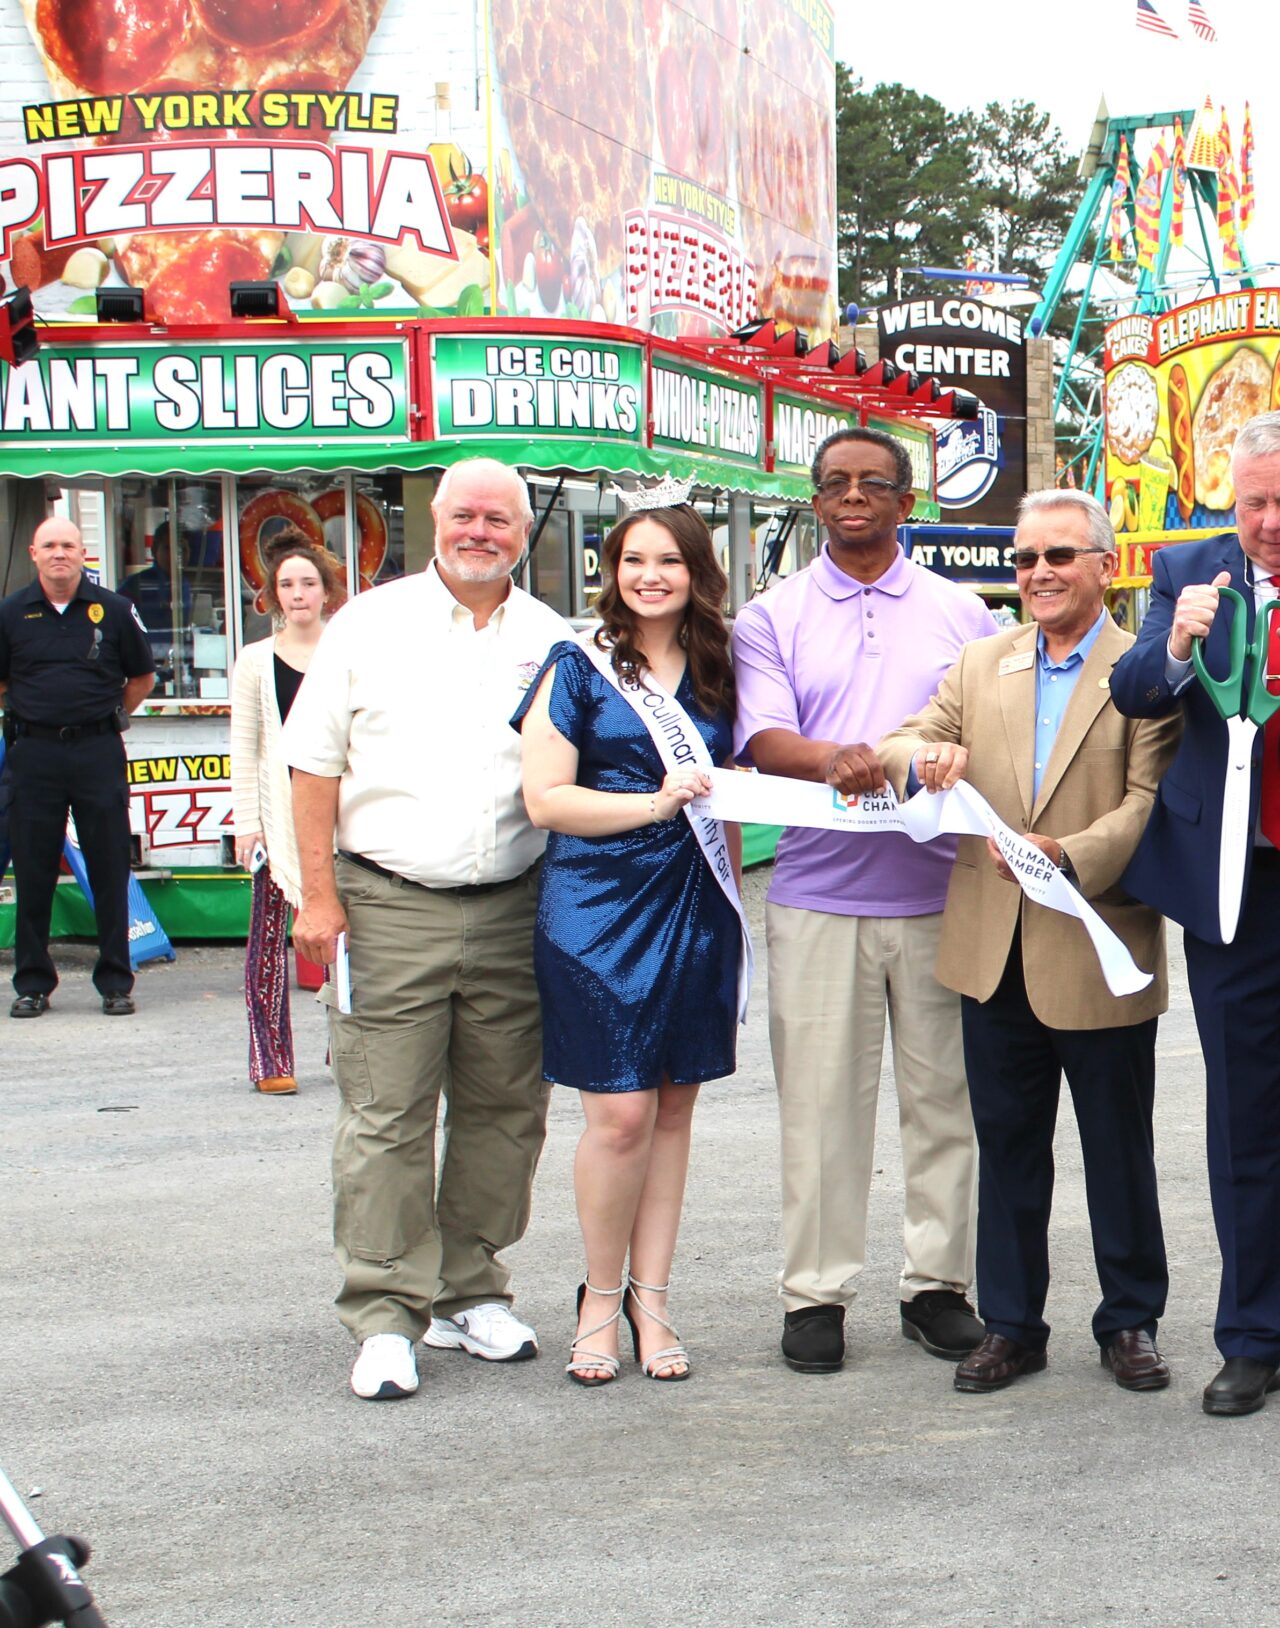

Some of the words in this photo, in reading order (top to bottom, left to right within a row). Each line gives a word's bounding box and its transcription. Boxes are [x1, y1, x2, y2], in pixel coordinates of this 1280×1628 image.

[25, 99, 122, 141] NEW
[135, 94, 250, 129] YORK
[263, 93, 397, 132] STYLE
[0, 147, 455, 256] PIZZERIA
[655, 175, 677, 205] NEW
[680, 180, 705, 216] YORK
[706, 191, 735, 238] STYLE
[625, 215, 757, 332] PIZZERIA
[881, 300, 1023, 346] WELCOME
[1105, 315, 1154, 350] FUNNEL
[1157, 293, 1253, 357] ELEPHANT
[486, 345, 545, 376] ICE
[550, 347, 620, 381] COLD
[895, 343, 1011, 378] CENTER
[1111, 335, 1150, 362] CAKES
[0, 356, 139, 431] ANT
[153, 351, 396, 431] SLICES
[451, 378, 638, 433] DRINKS
[651, 367, 708, 446] WHOLE
[710, 383, 758, 458] PIZZAS
[778, 402, 849, 468] NACH
[910, 544, 937, 567] AT
[940, 545, 1000, 567] YOUR
[183, 756, 231, 780] YO
[713, 844, 731, 882] Fair
[998, 831, 1055, 872] CULLMAN
[1000, 845, 1053, 883] HAMBER
